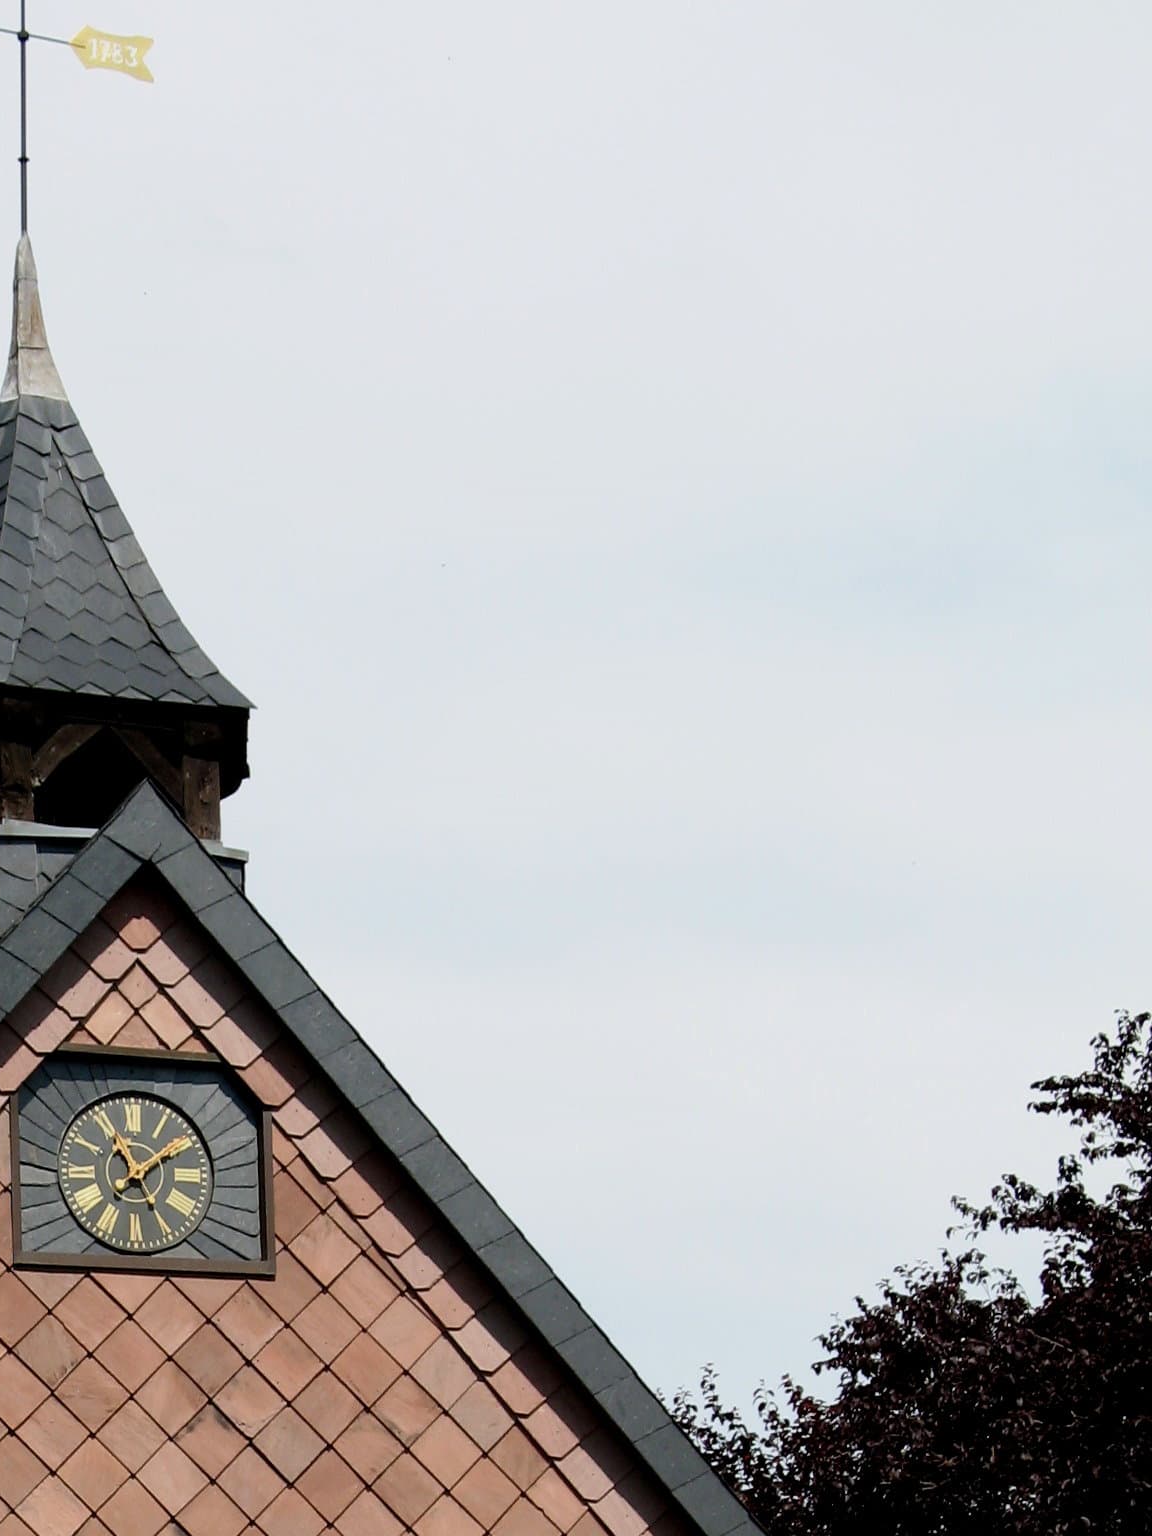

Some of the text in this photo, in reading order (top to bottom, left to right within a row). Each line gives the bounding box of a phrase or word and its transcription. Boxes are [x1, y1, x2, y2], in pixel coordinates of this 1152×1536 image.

[93, 1110, 116, 1140] XI
[125, 1104, 142, 1132] XII
[152, 1113, 168, 1138] I
[74, 1134, 102, 1156] X
[68, 1162, 96, 1180] IX
[174, 1168, 201, 1183] III
[73, 1183, 104, 1213] VIII
[96, 1203, 120, 1234] VII
[129, 1213, 144, 1242] VI
[154, 1209, 171, 1236] V
